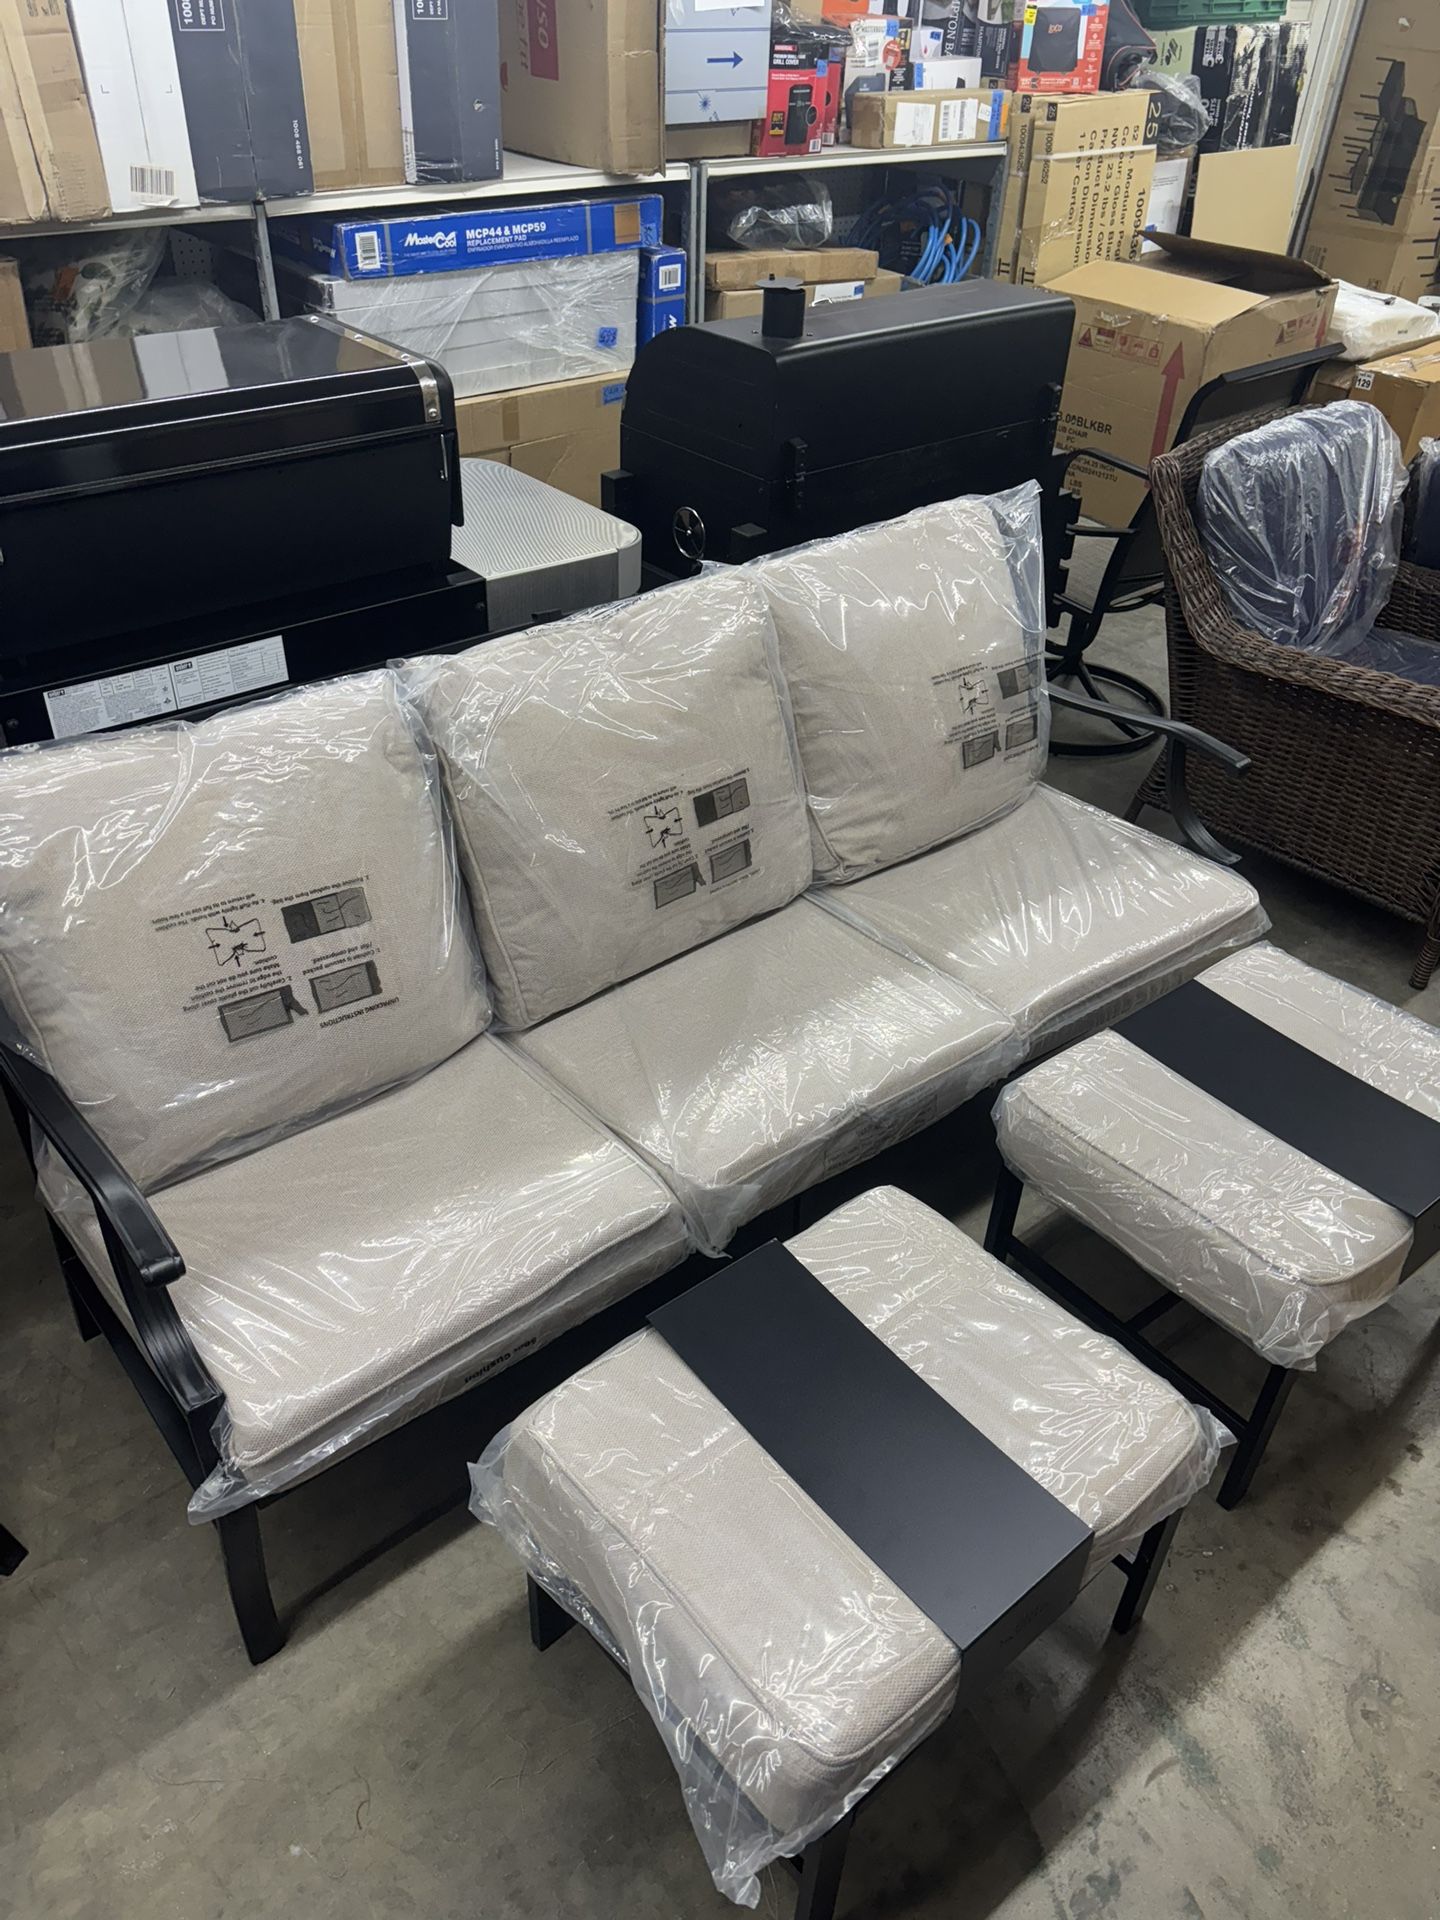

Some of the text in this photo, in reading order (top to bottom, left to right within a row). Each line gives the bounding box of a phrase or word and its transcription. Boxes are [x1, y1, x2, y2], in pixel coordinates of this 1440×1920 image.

[416, 0, 424, 14] 10
[1131, 125, 1140, 141] 52
[1146, 102, 1161, 138] 25
[1084, 130, 1097, 181] Caton
[1116, 126, 1129, 180] Coour:
[1103, 162, 1114, 193] 23.2
[1099, 196, 1108, 219] lbs
[1109, 185, 1120, 226] Gloss
[1119, 168, 1134, 225] Modular
[404, 231, 458, 248] MasterCool
[466, 222, 547, 239] MCP44 & MCP59
[467, 236, 513, 247] REPLACEMENT
[1357, 378, 1371, 388] 129
[319, 996, 400, 1029] UNPACKING INSTRUCTIONS
